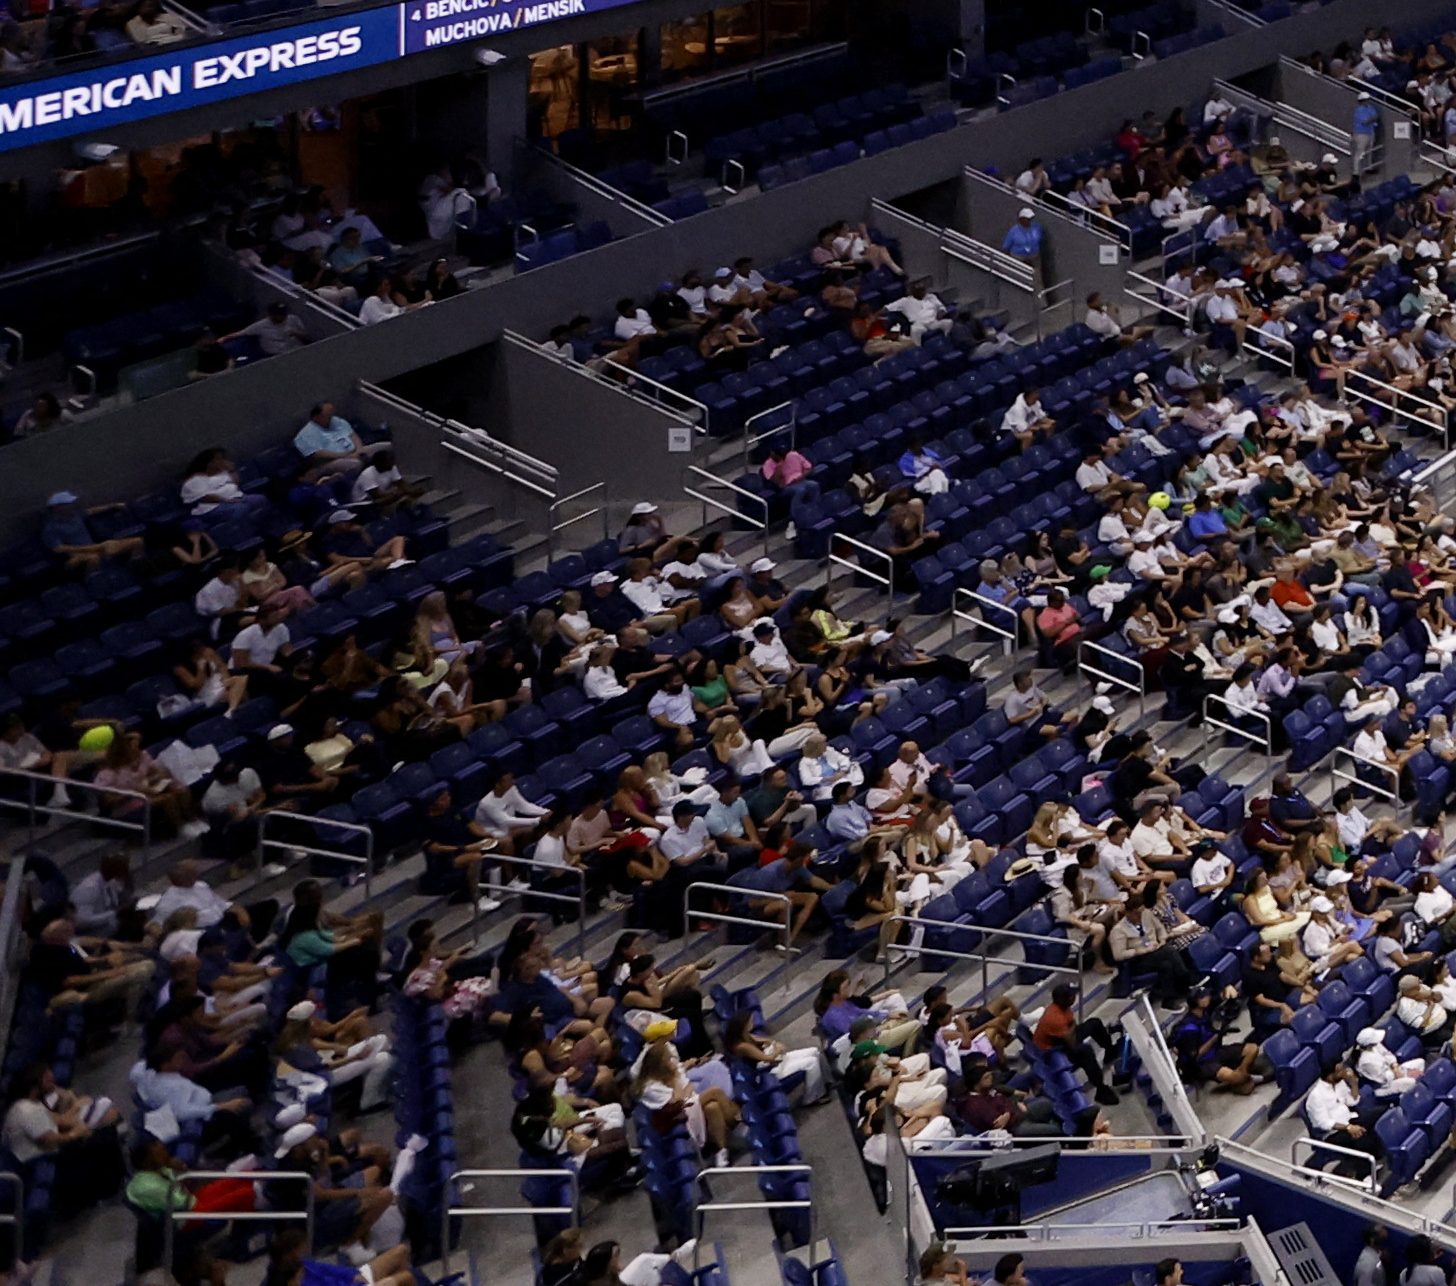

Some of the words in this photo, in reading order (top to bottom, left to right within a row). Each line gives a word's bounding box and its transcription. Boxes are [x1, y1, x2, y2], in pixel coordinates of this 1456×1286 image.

[411, 10, 422, 22] 4
[0, 65, 181, 133] MERICAN
[192, 26, 362, 90] EXPRESS
